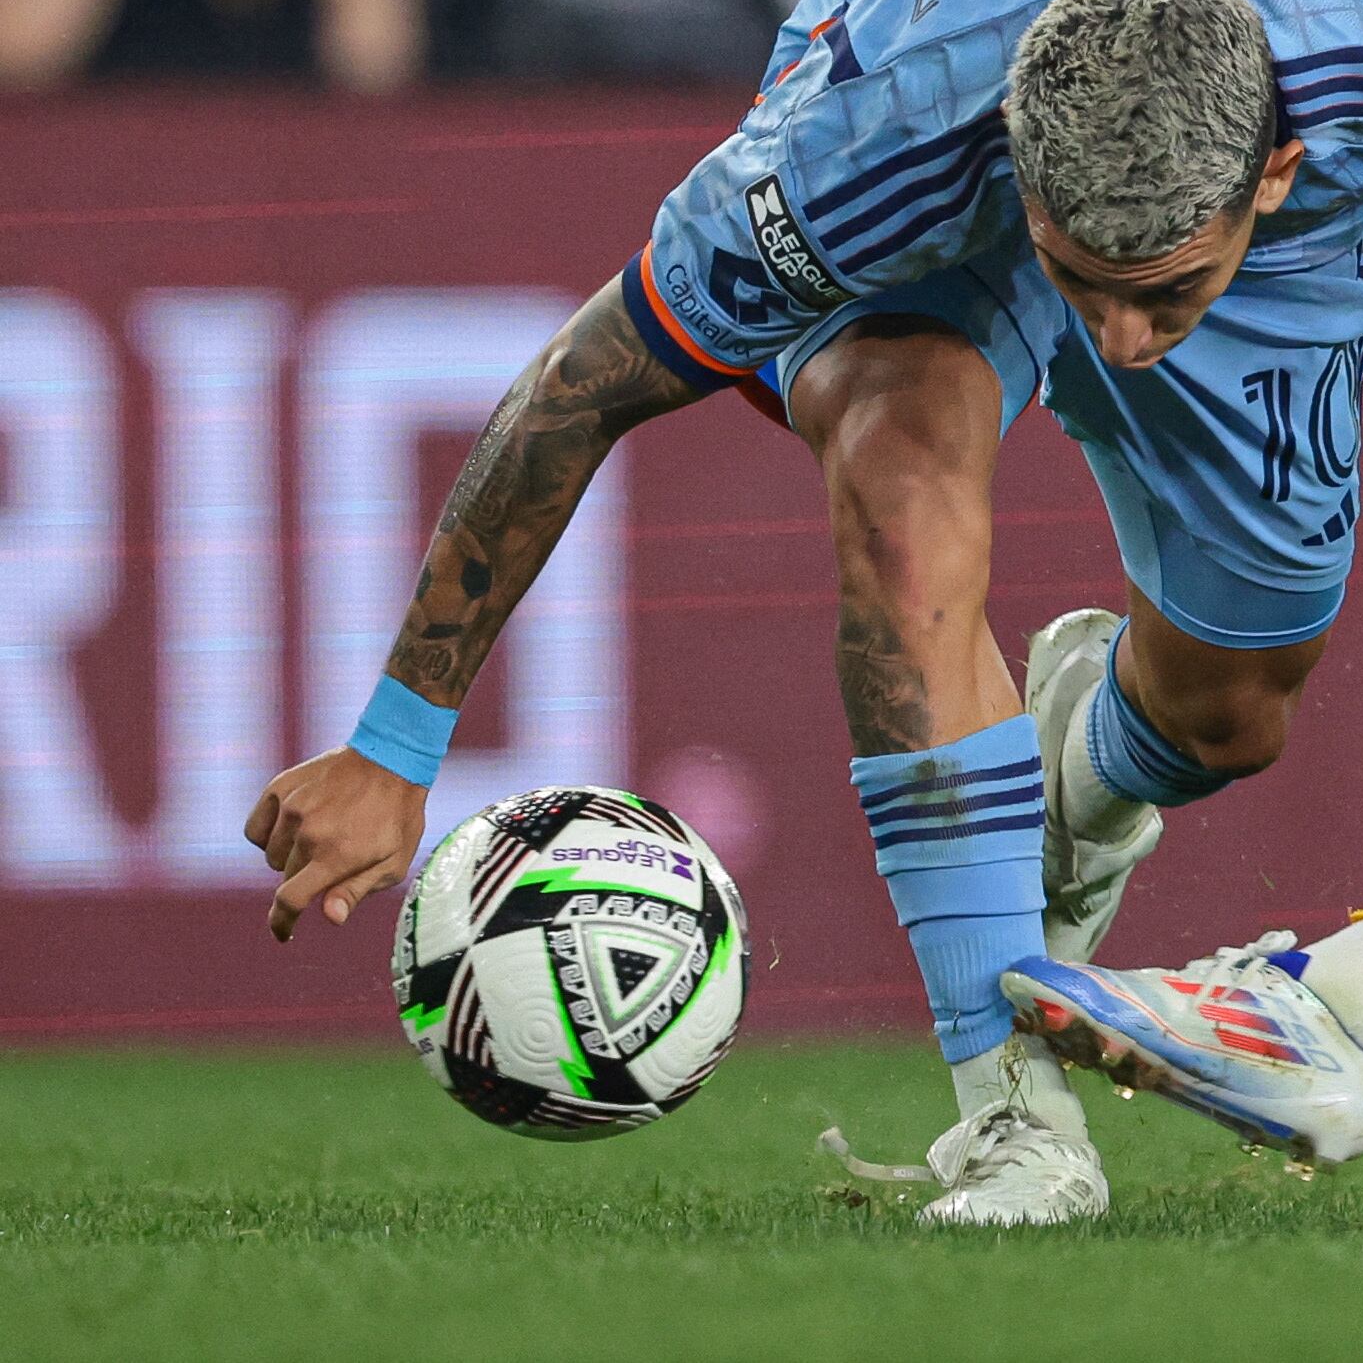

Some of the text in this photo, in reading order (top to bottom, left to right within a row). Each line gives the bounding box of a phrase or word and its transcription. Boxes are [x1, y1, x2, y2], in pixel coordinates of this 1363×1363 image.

[760, 226, 799, 278] CUP
[1242, 343, 1362, 503] 10
[551, 847, 668, 873] LEAGUES
[616, 839, 667, 858] CUP
